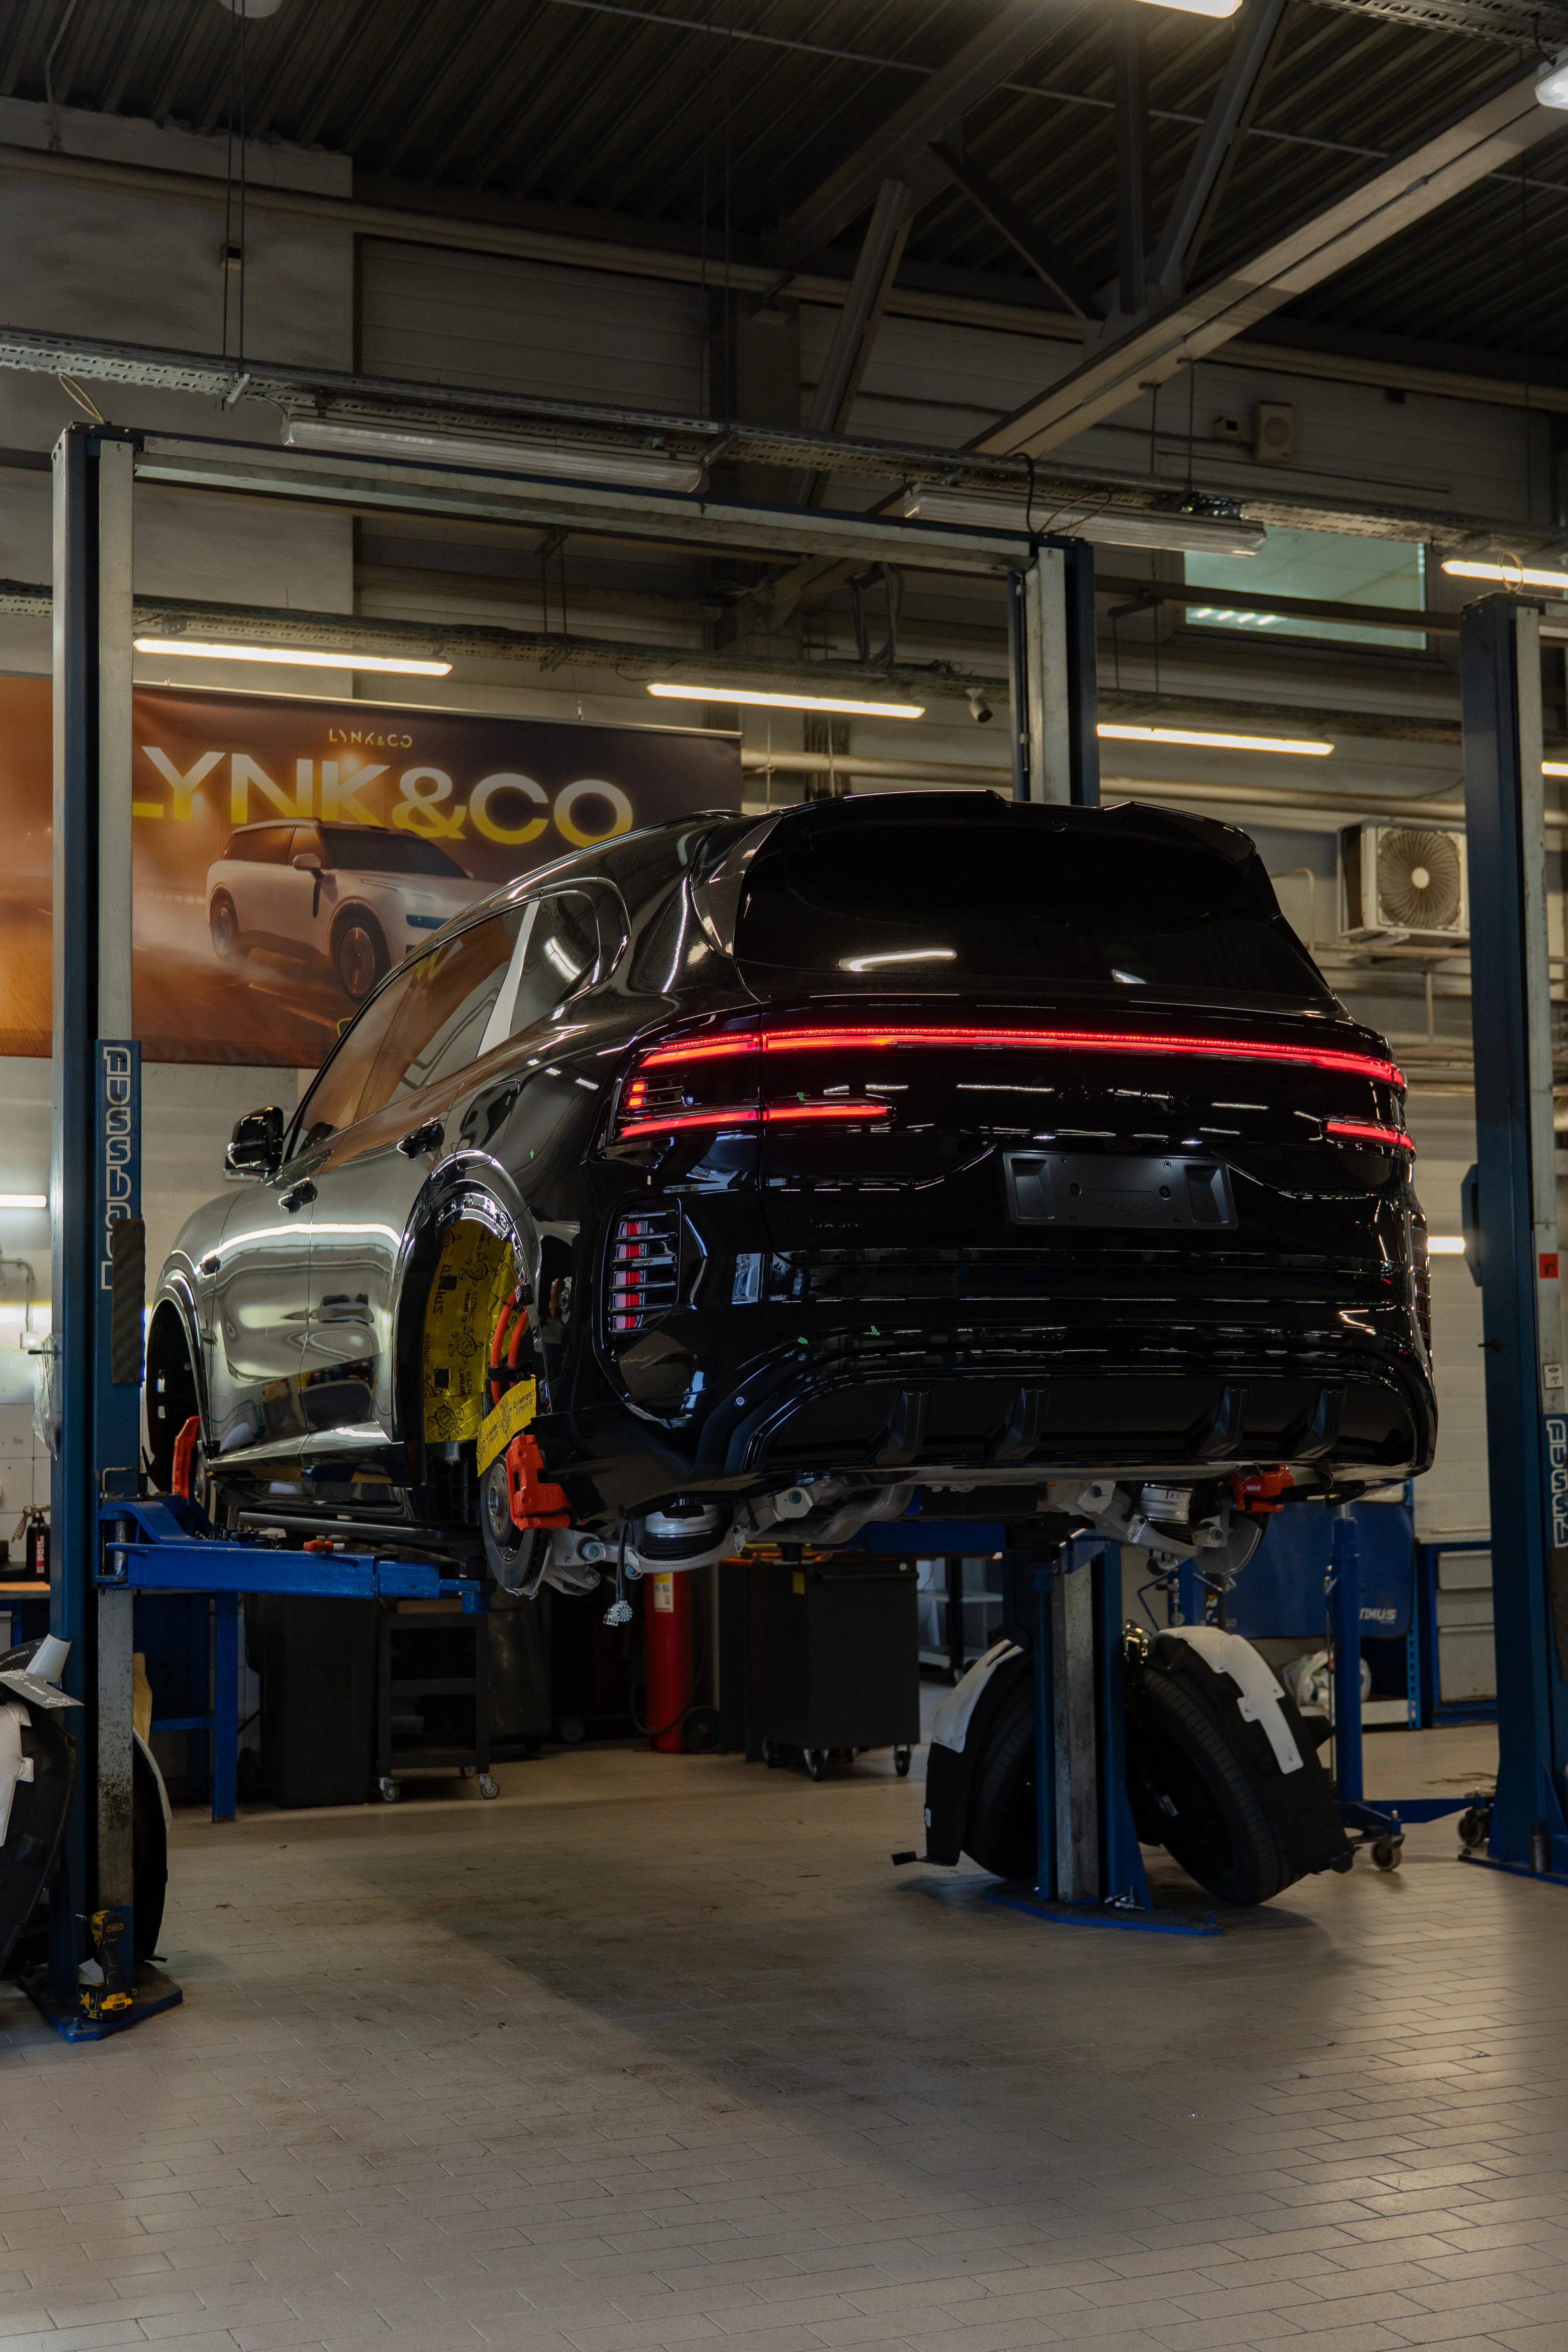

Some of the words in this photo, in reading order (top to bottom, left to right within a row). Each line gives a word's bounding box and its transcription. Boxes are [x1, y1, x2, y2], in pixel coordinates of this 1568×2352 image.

[329, 728, 413, 748] LYNK&CO
[1096, 1203, 1151, 1213] ZEEKR
[462, 1289, 472, 1322] CMFORT
[513, 1389, 535, 1408] CMFORT
[515, 1398, 533, 1416] SPIDER
